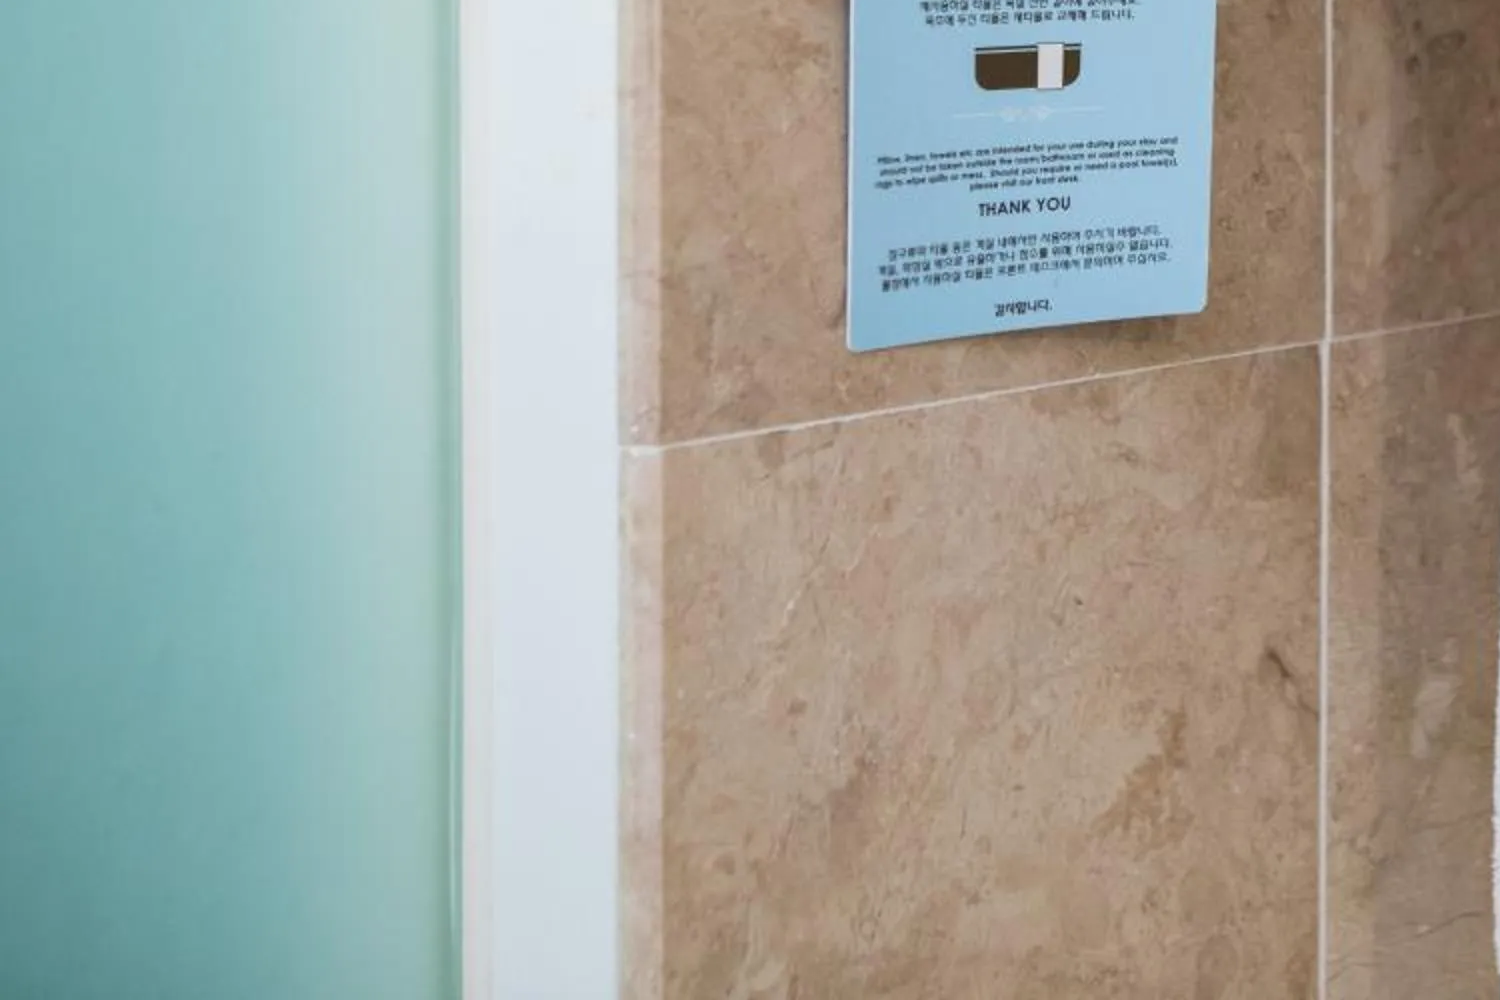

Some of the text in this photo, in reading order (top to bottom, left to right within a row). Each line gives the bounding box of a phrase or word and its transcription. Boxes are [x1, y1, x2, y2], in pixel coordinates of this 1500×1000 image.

[978, 196, 1072, 217] THANK YOU
[994, 299, 1053, 317] 감사합니다.
